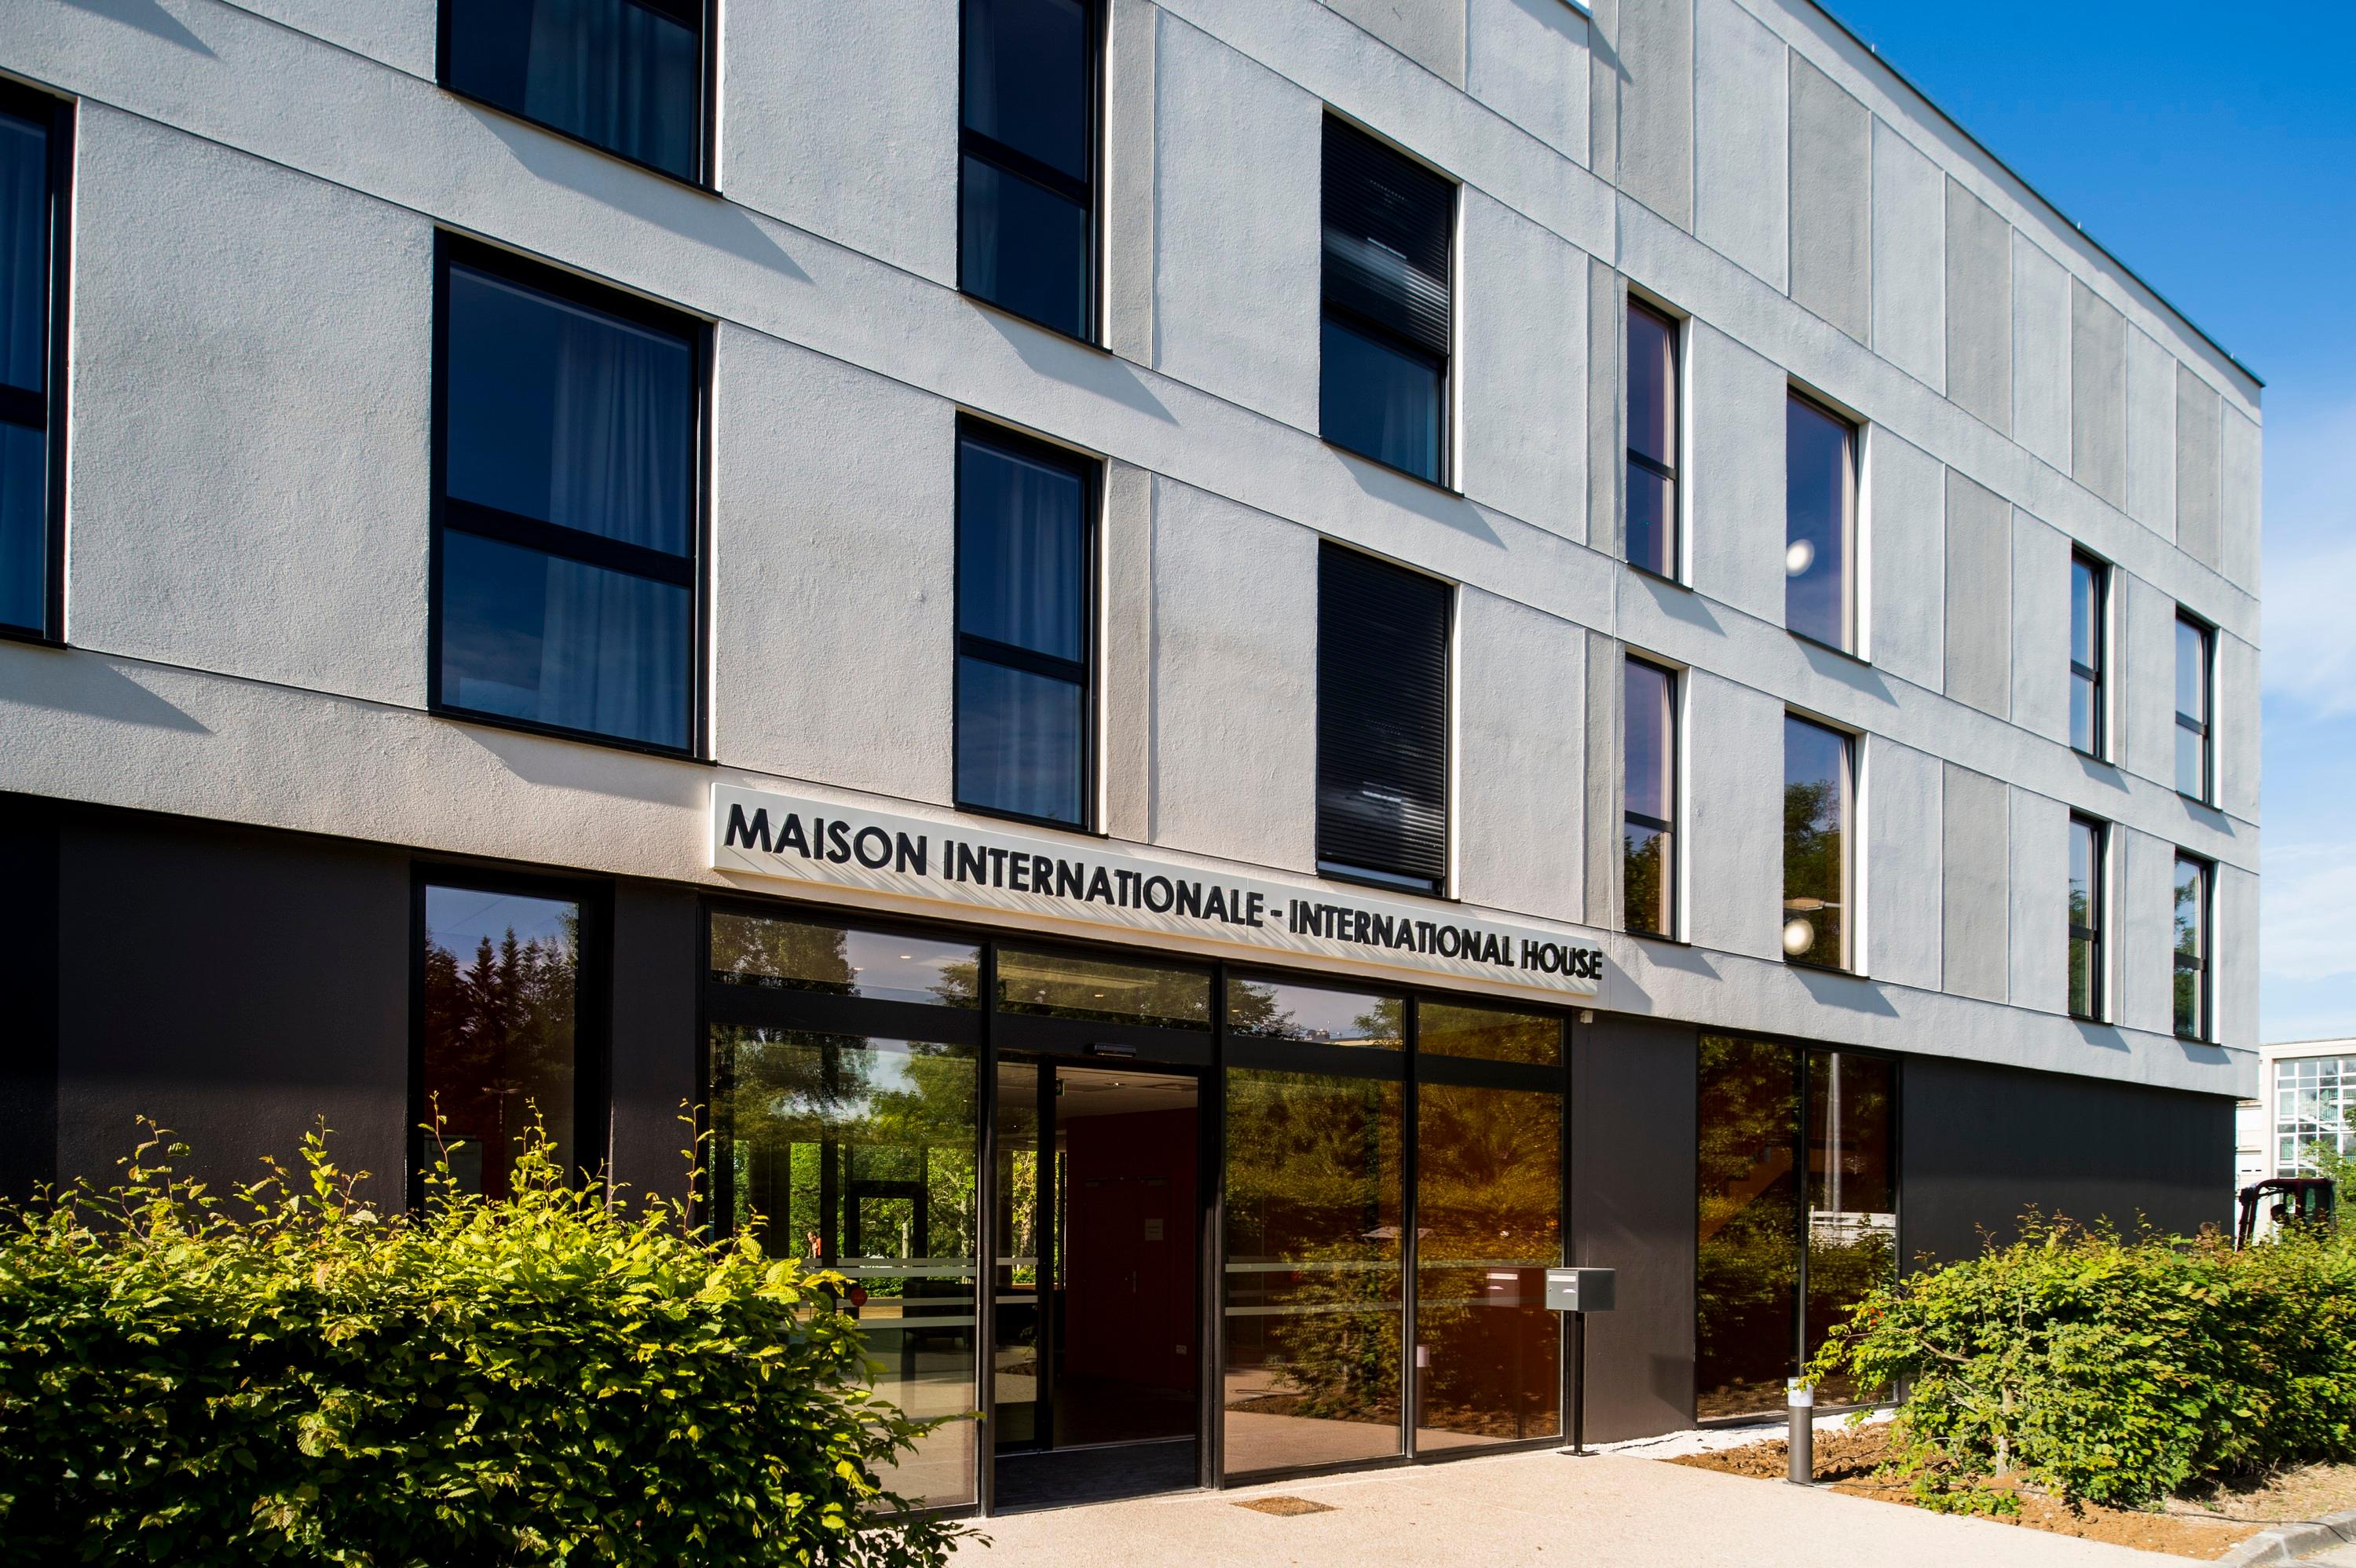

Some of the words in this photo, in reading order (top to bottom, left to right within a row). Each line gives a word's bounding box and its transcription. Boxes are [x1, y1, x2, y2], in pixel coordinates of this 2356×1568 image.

[724, 803, 927, 875] MAISON
[944, 840, 1263, 927] INTERNATIONALE
[1290, 899, 1514, 967] INTERNATIONAL
[1521, 939, 1602, 980] HOUSE
